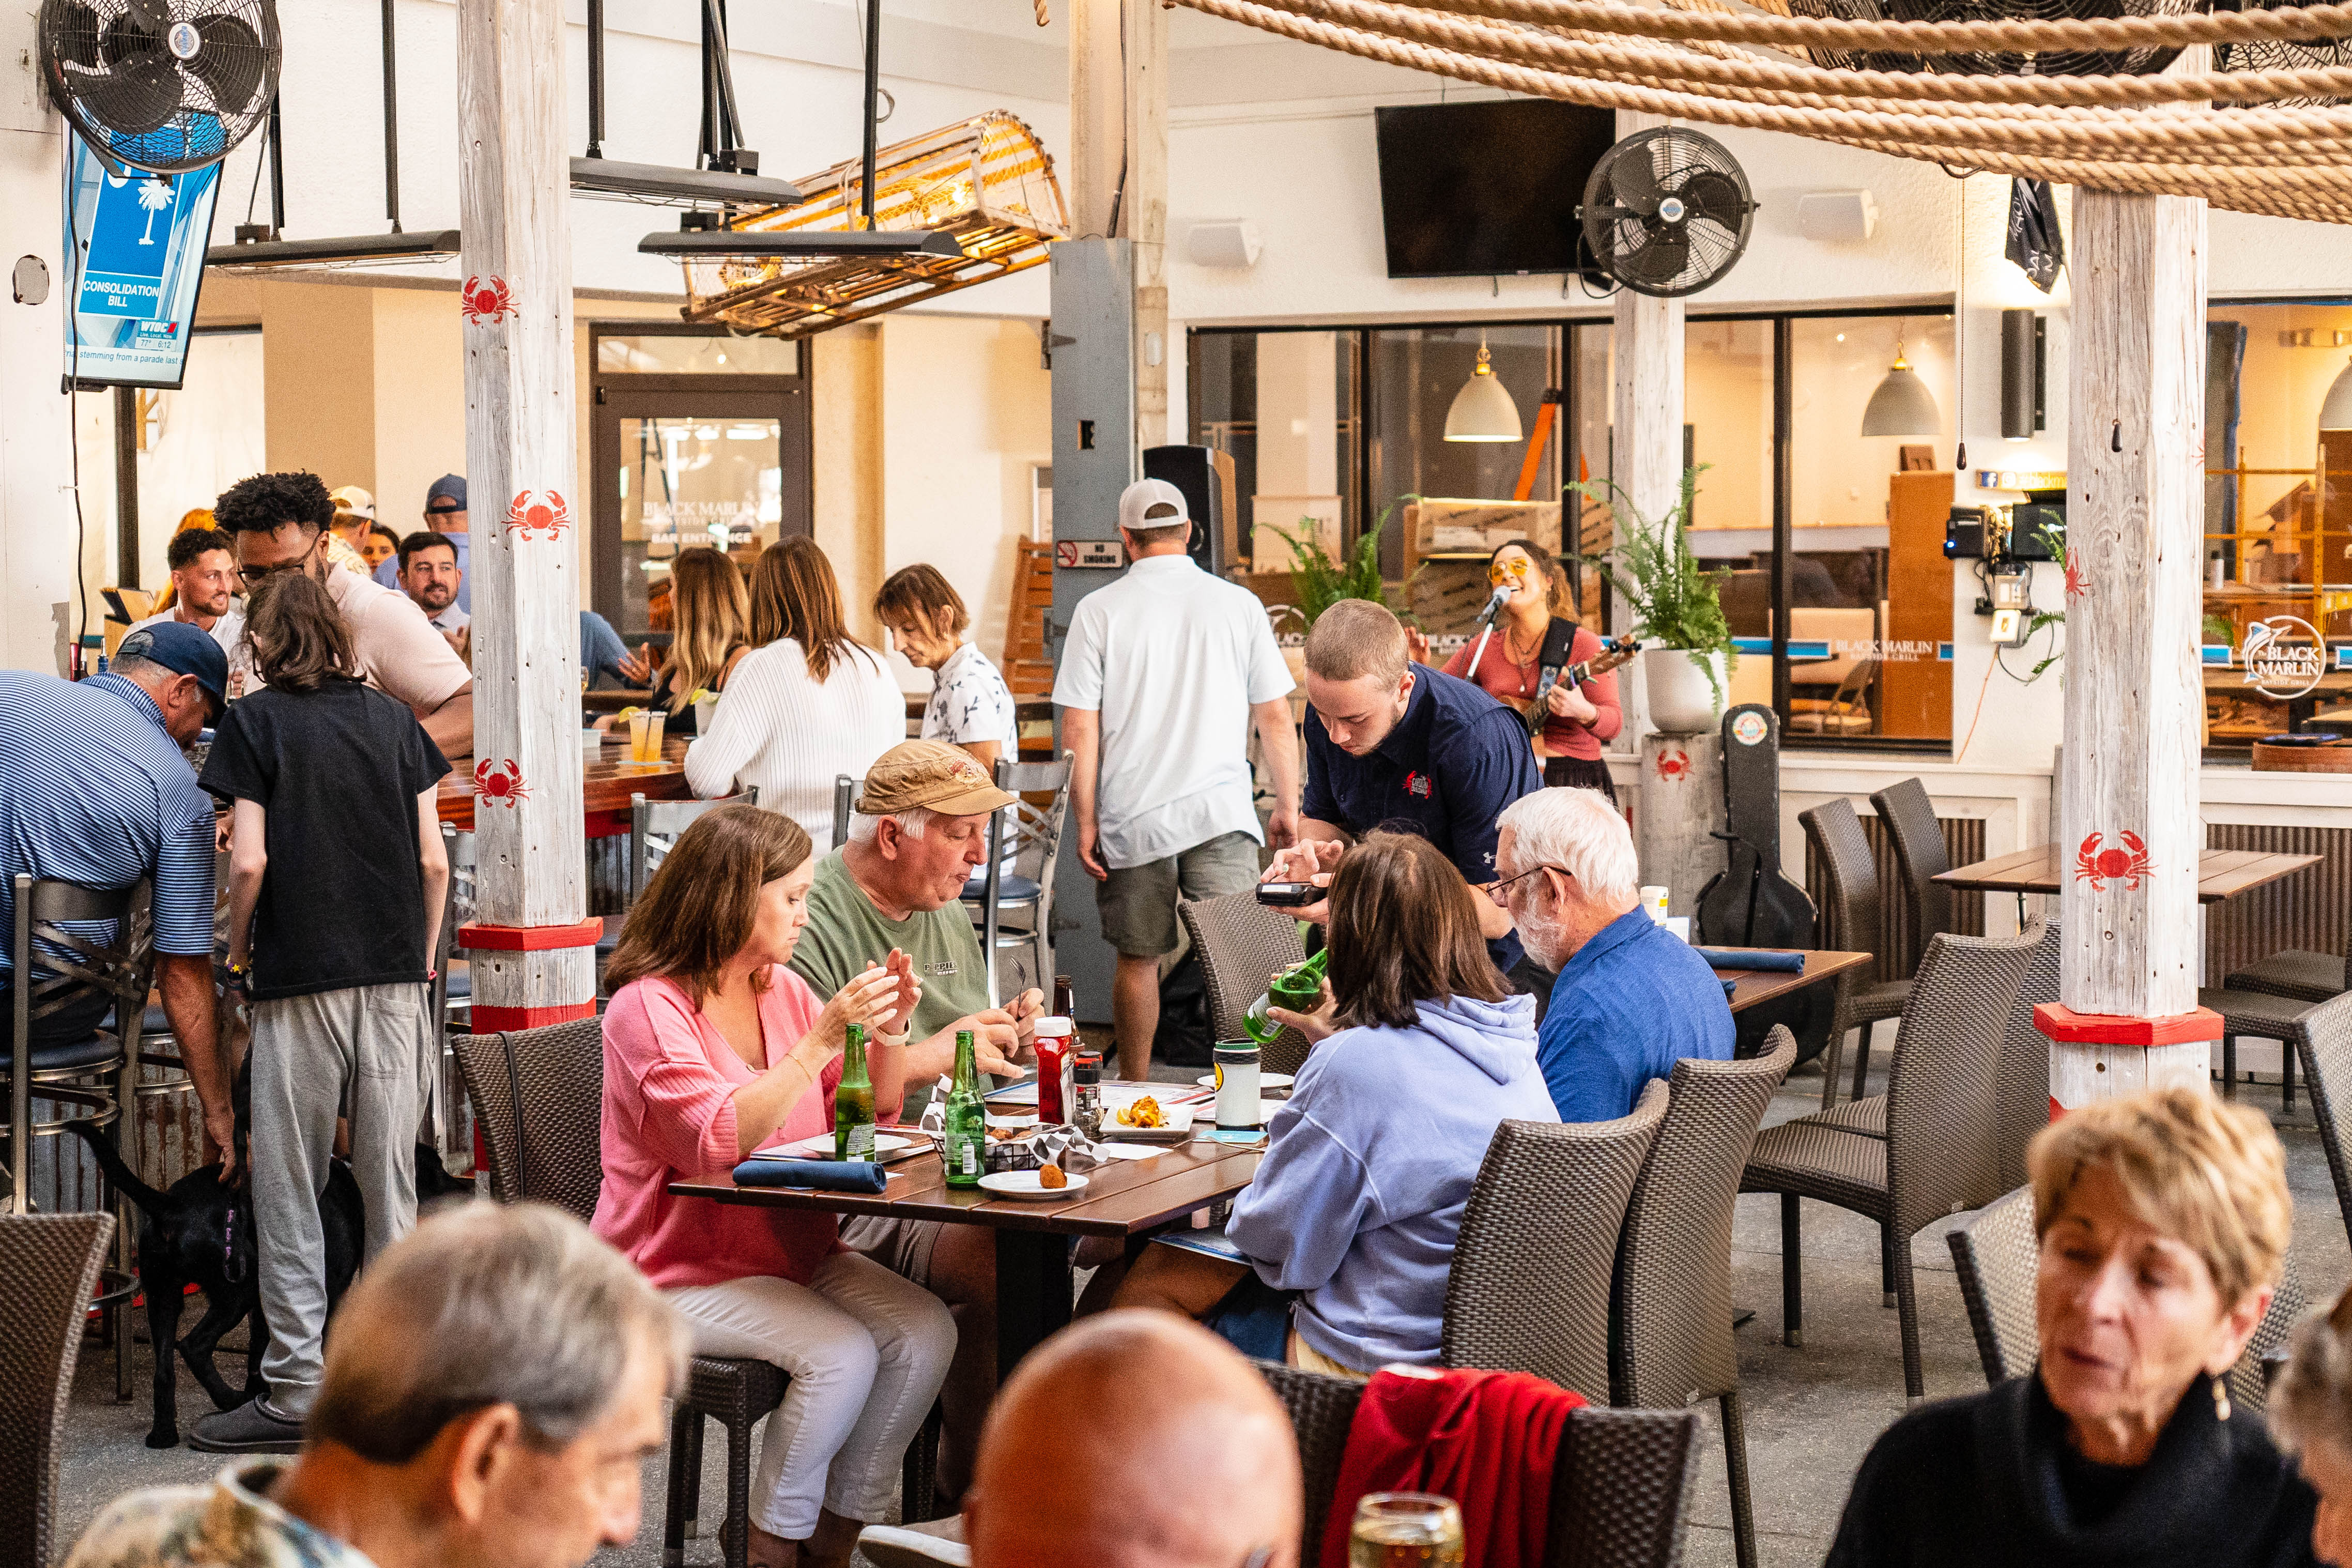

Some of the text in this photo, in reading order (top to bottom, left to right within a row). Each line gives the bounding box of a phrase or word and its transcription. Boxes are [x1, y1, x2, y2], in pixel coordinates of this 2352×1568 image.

[83, 280, 160, 297] CONSOLIDATION
[107, 295, 128, 307] BILL
[141, 321, 168, 332] WTOC
[80, 351, 114, 362] stemming
[116, 352, 132, 361] from
[140, 356, 164, 364] parade
[165, 356, 178, 364] last
[652, 533, 679, 543] BAR
[1095, 544, 1105, 552] NO
[1083, 555, 1116, 564] SMOKING
[1835, 639, 1933, 654] BLACK MARLIN
[2267, 646, 2320, 662] BLACK
[2257, 661, 2320, 676] MARLIN
